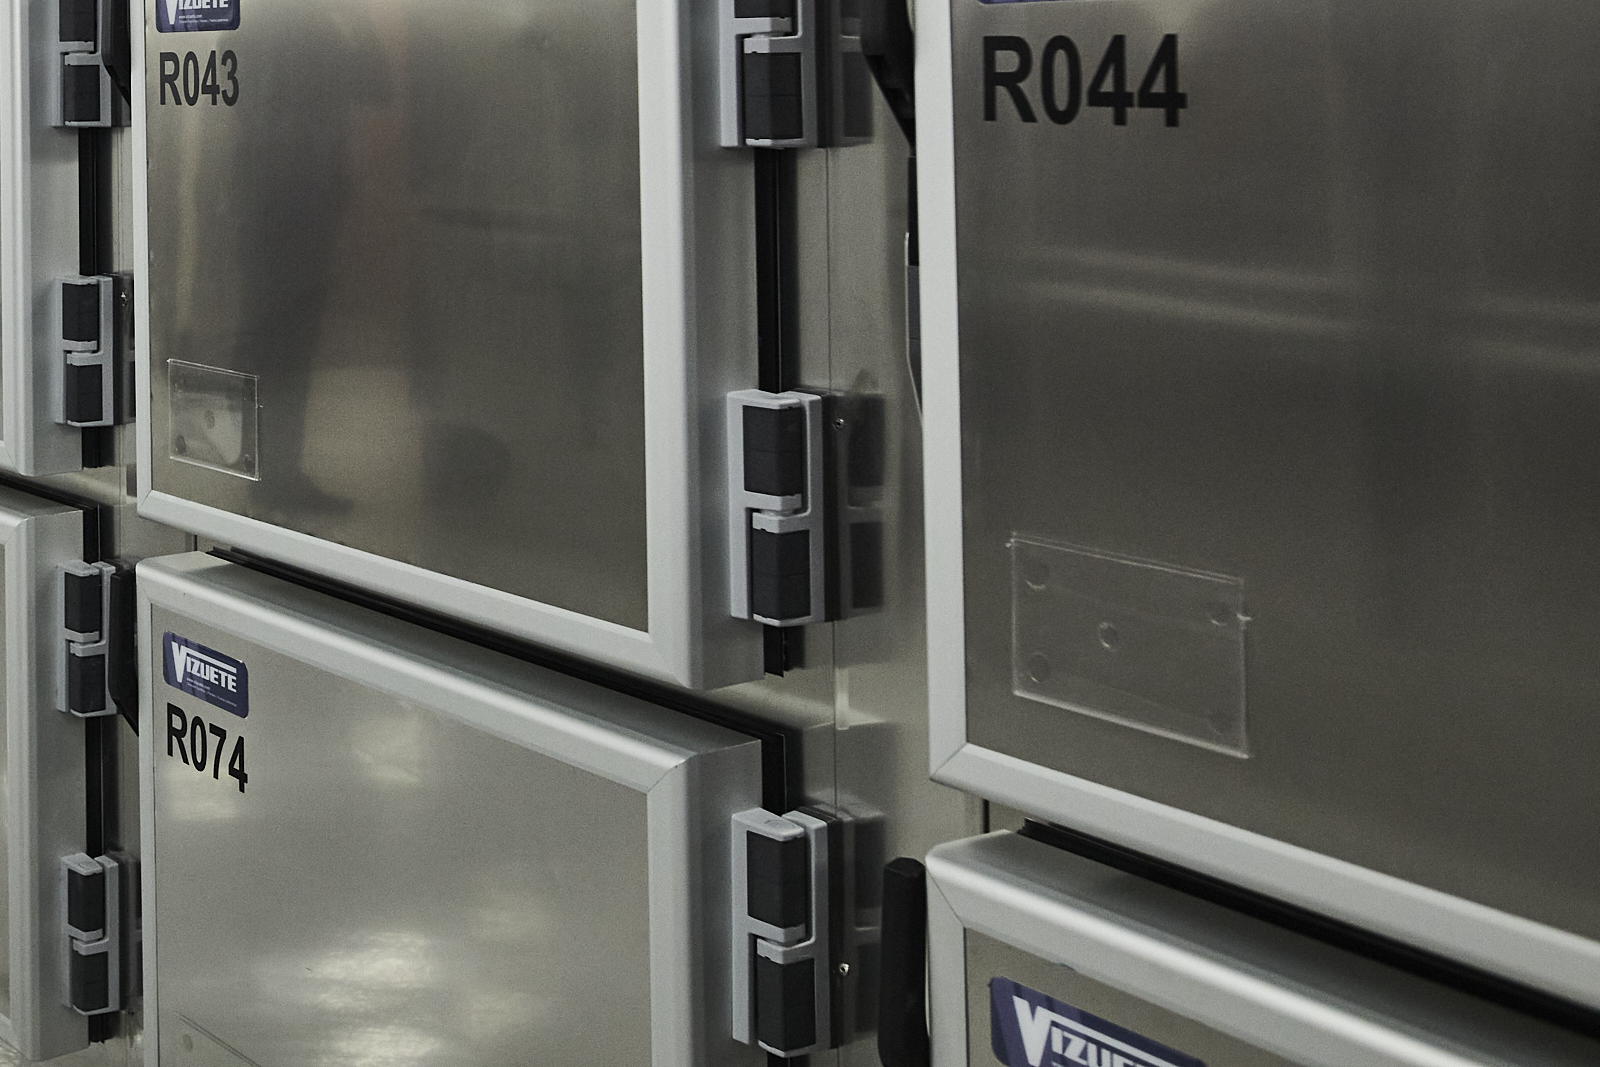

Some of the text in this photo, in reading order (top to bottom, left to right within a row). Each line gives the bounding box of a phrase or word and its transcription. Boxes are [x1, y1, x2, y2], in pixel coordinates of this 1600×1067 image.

[159, 50, 240, 107] R043
[983, 34, 1188, 128] R044
[171, 641, 237, 693] VIZUETE
[167, 702, 248, 794] R074
[1012, 995, 1178, 1067] VIZU
